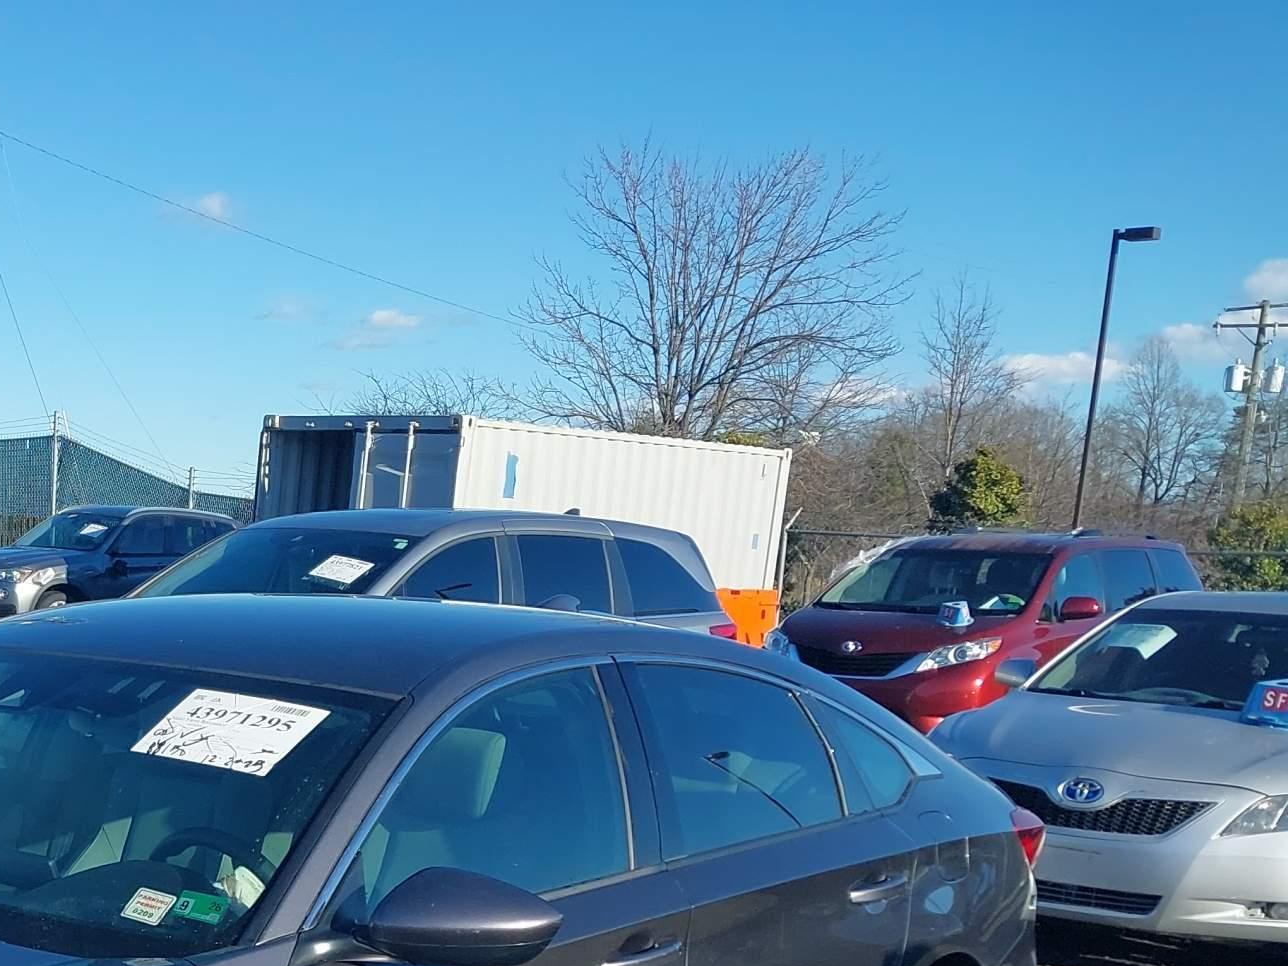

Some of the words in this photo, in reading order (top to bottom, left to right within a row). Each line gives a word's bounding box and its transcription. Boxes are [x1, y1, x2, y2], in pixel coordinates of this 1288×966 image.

[1263, 690, 1288, 709] SF
[186, 705, 297, 732] 43971295
[136, 900, 163, 911] PERMIT
